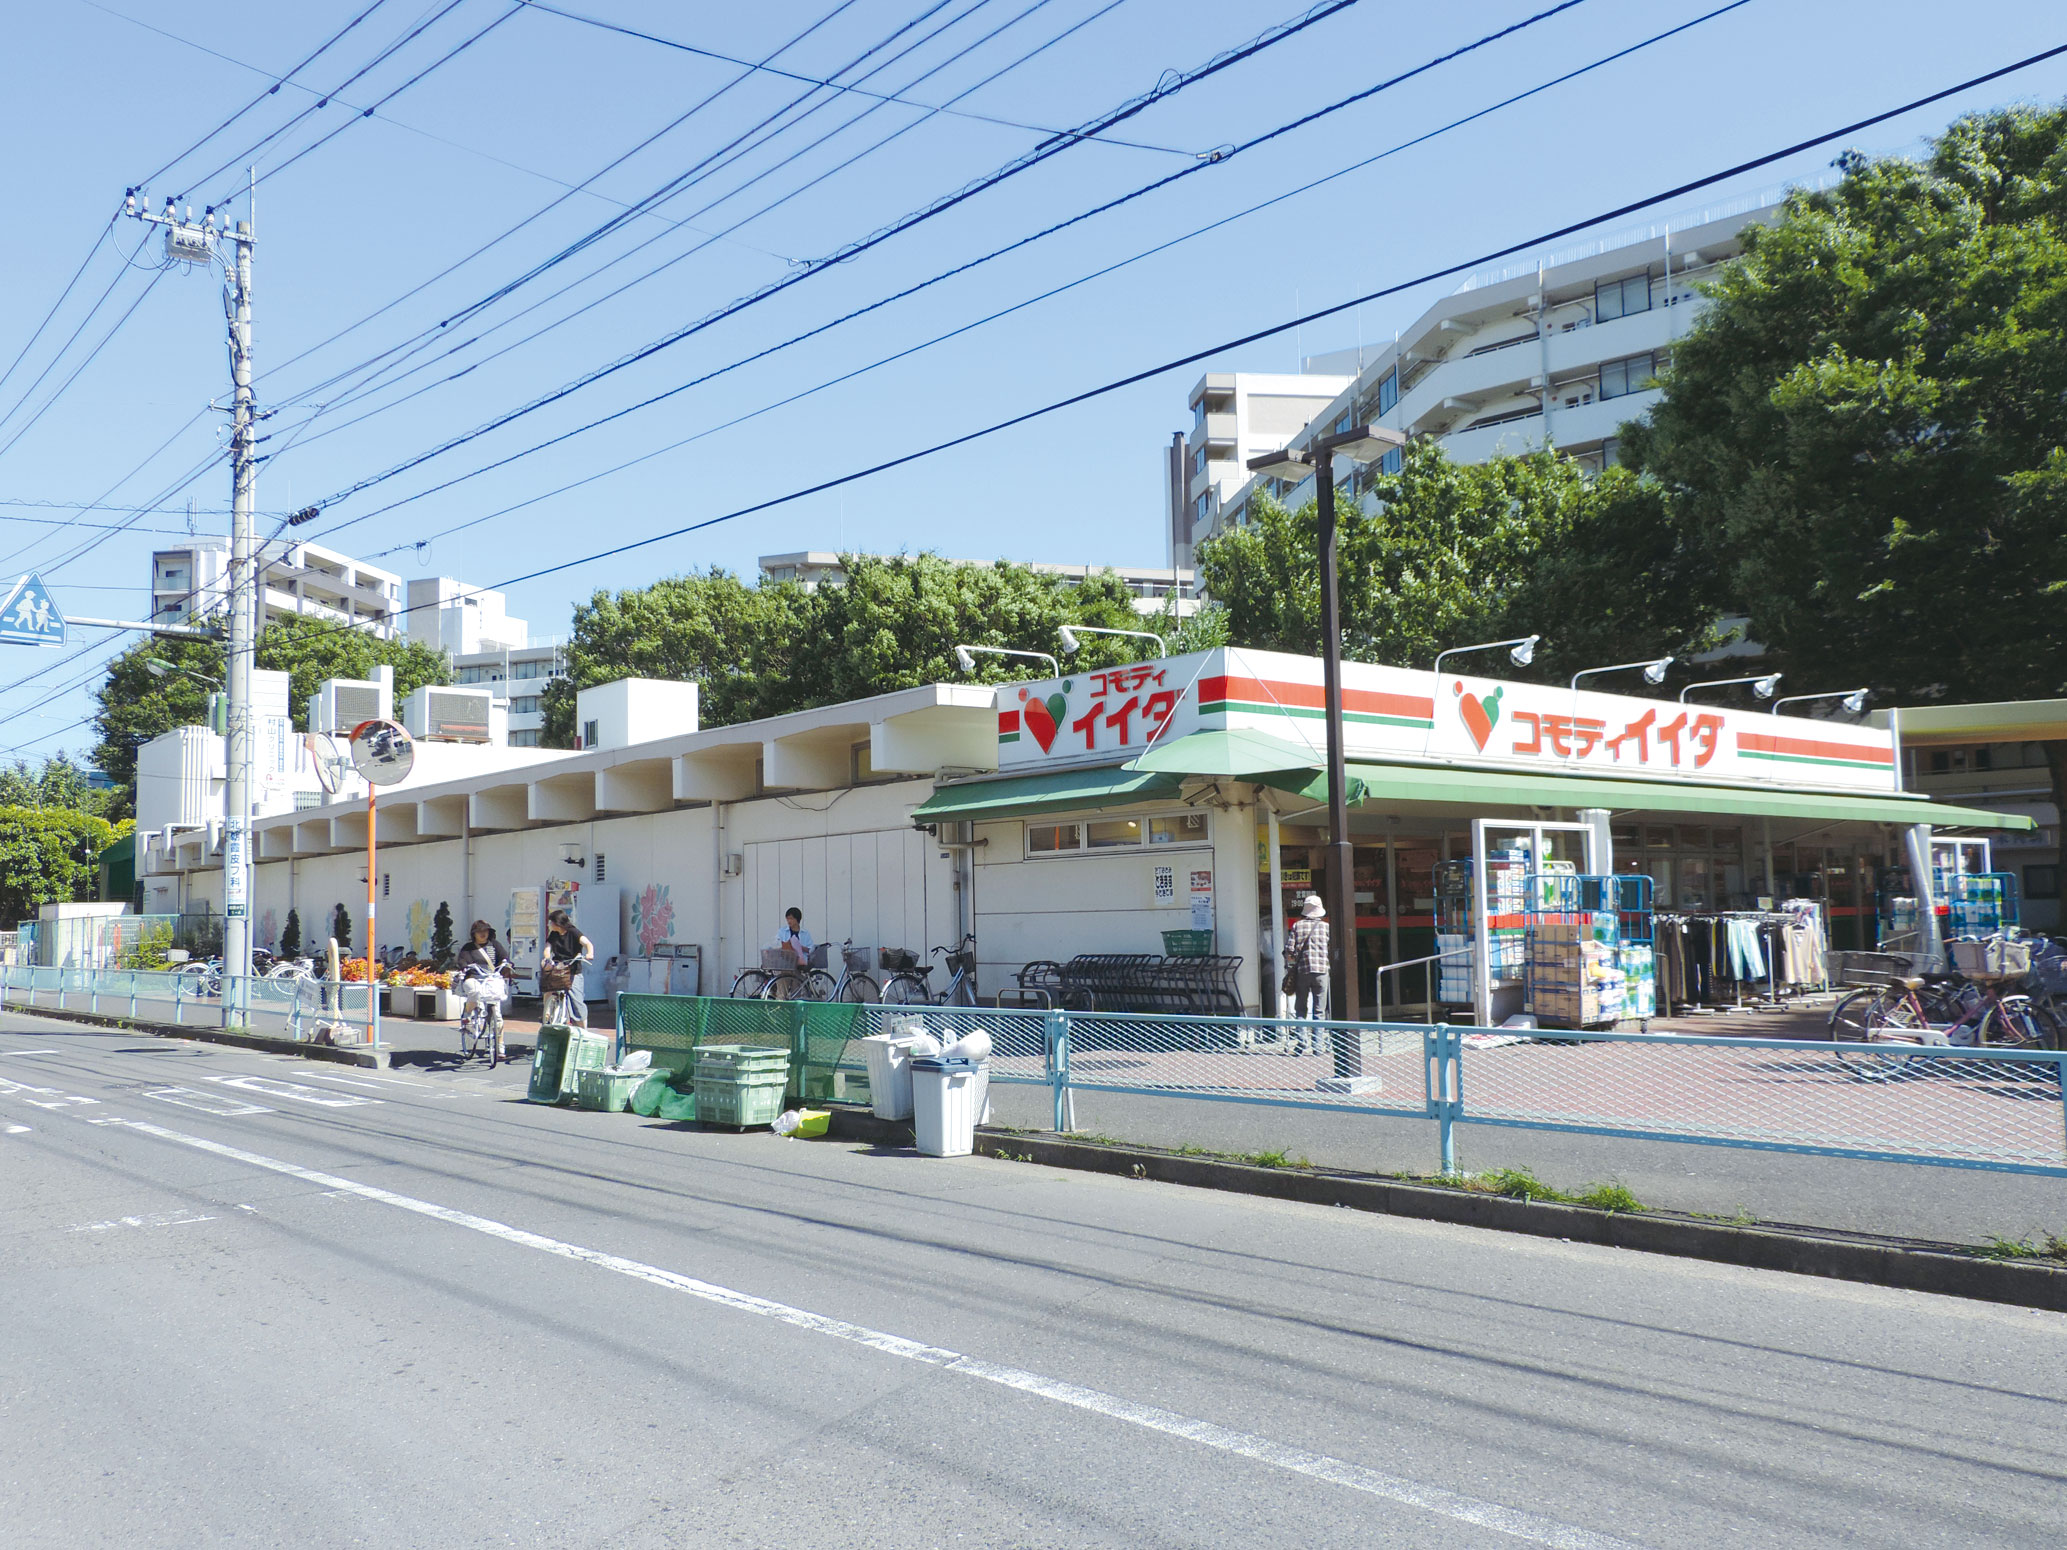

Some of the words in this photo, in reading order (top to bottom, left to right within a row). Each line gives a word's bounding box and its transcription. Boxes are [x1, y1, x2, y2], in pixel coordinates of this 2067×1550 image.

[1090, 665, 1167, 698] コモディ
[267, 718, 276, 772] 村山クリニック
[1072, 687, 1187, 750] イイダ
[1511, 707, 1725, 769] コモディイイダ
